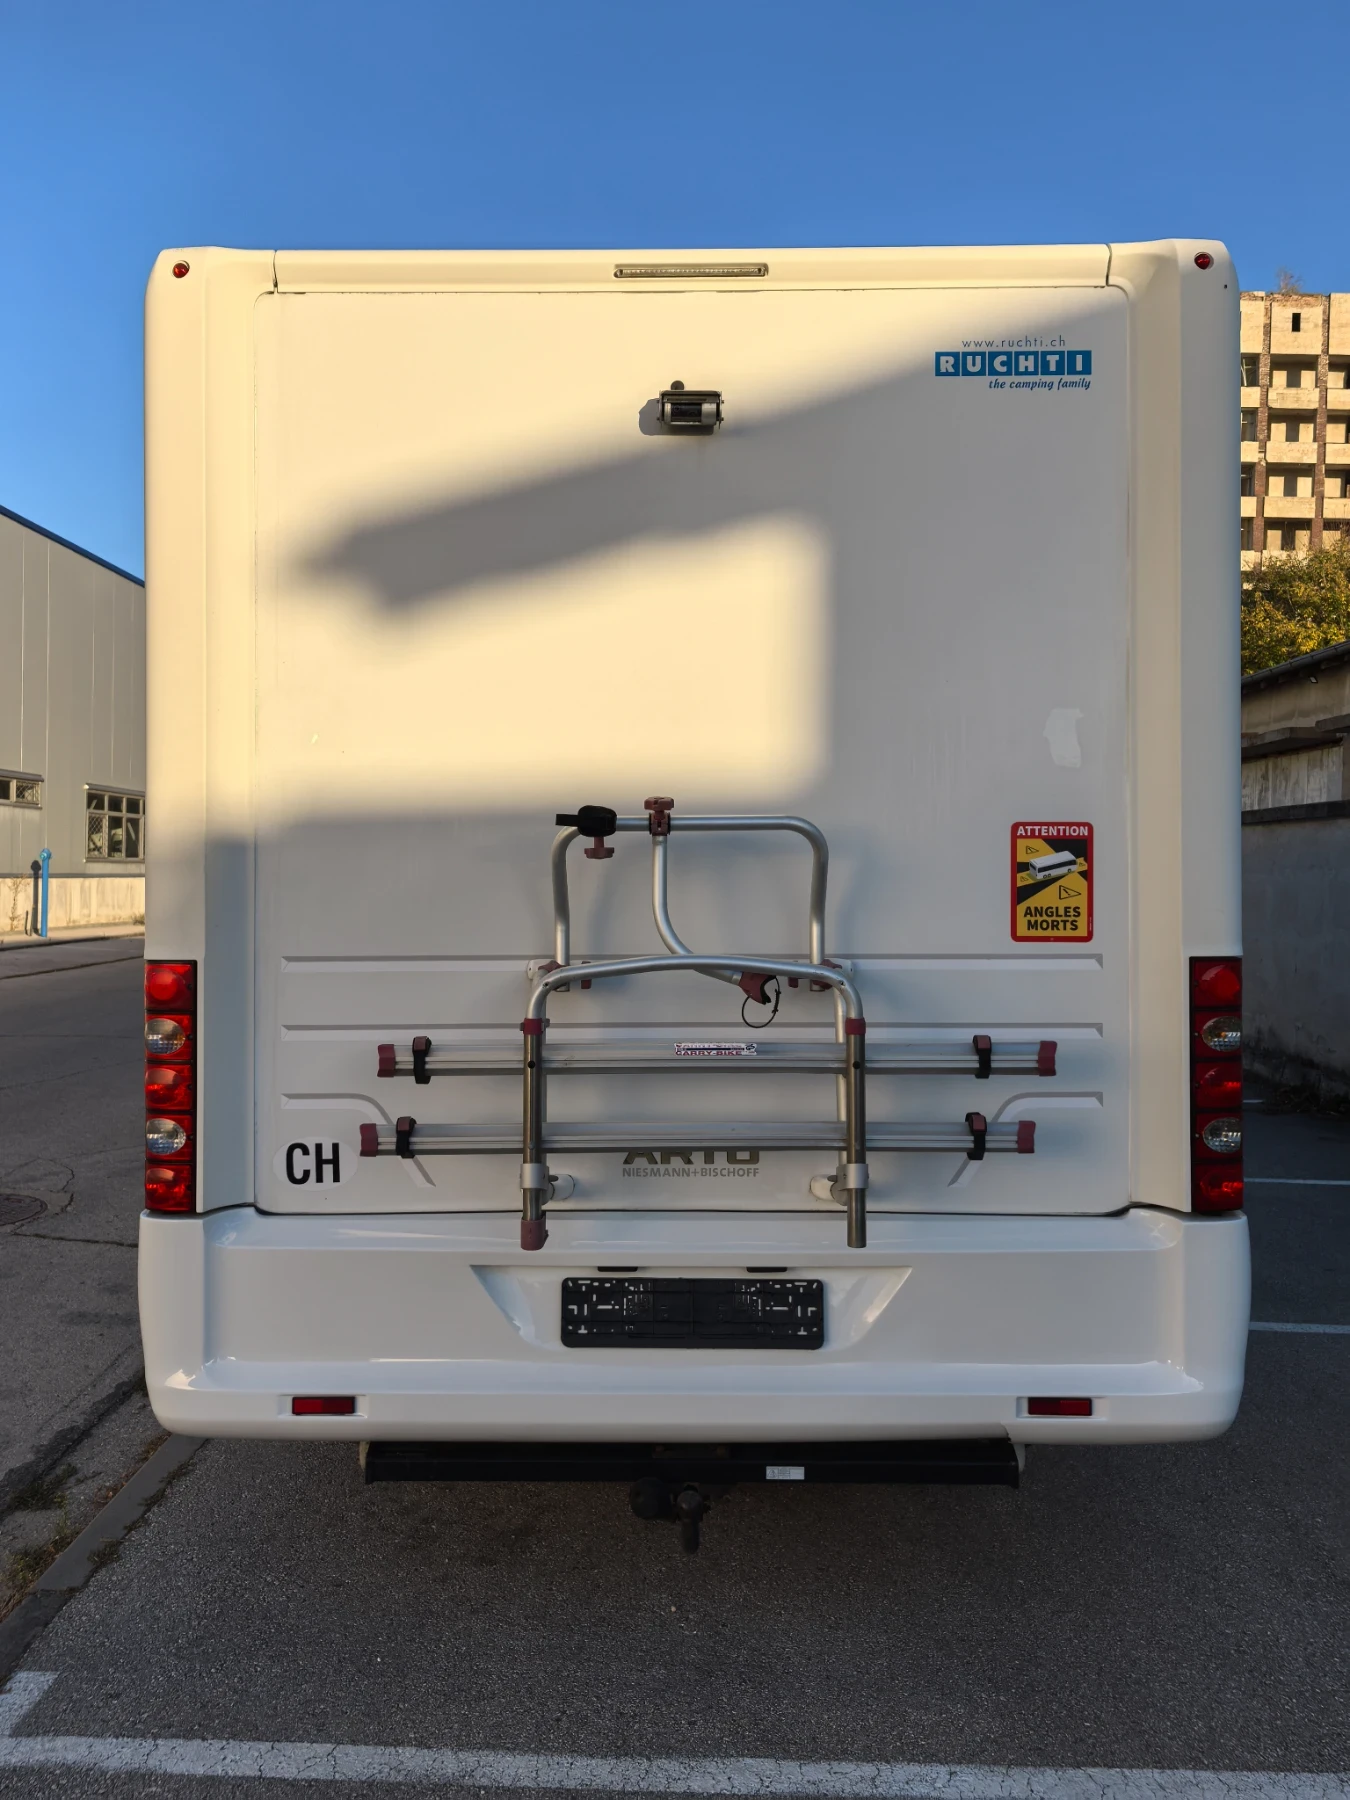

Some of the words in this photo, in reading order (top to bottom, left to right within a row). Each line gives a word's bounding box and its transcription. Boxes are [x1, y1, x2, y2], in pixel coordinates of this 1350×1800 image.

[961, 335, 1066, 348] www.ruchti.ch
[938, 354, 1084, 374] RUCHTI
[988, 379, 1006, 389] the
[1009, 379, 1054, 391] camping
[1057, 378, 1091, 390] family
[1017, 826, 1088, 836] ATTENTION
[1023, 906, 1081, 918] ANGLES
[1027, 919, 1078, 931] MORTS
[286, 1142, 340, 1185] CH
[622, 1167, 760, 1177] NIESMANN+BISCHOFF
